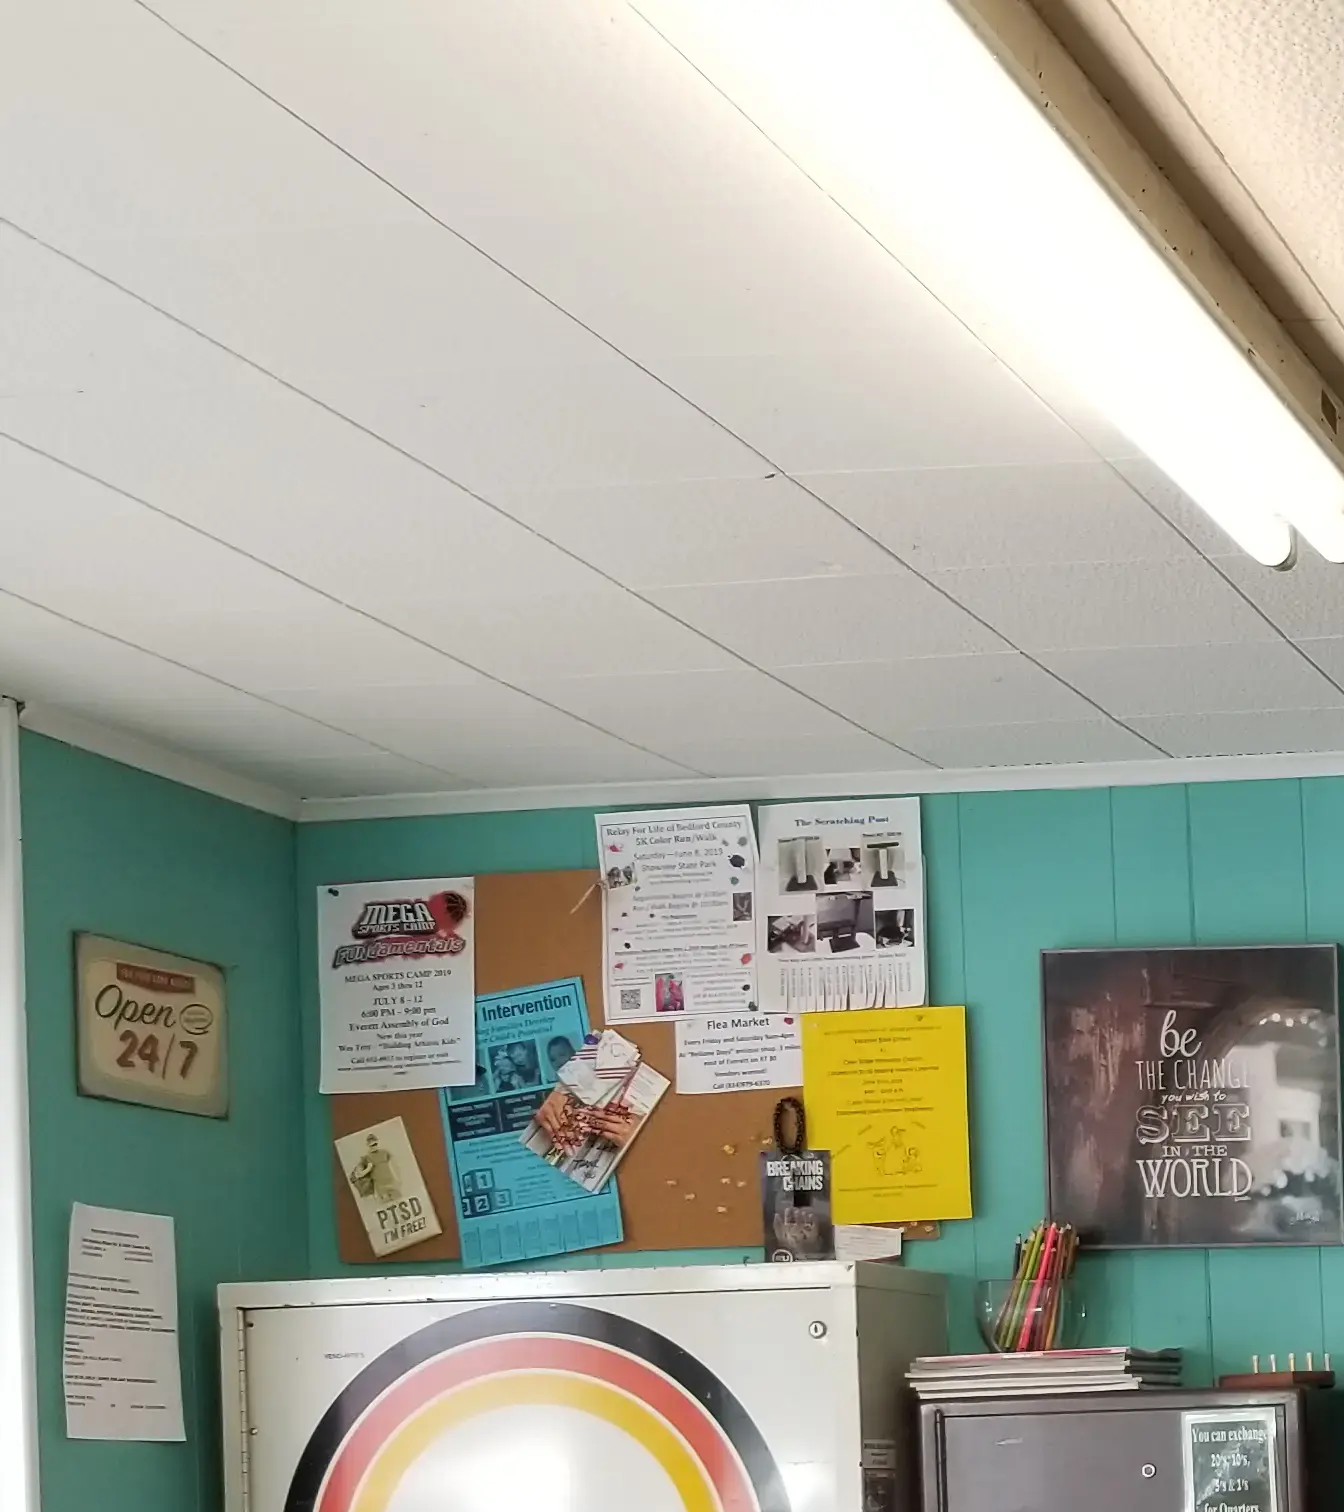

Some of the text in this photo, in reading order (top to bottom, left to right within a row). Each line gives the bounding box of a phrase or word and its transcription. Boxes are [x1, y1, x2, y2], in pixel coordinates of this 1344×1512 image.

[633, 826, 645, 834] For
[648, 825, 663, 833] Life
[676, 823, 710, 832] Bedford
[712, 821, 742, 829] County
[795, 819, 812, 827] The
[815, 817, 865, 826] Scratching
[360, 903, 434, 925] MEGA
[357, 923, 400, 934] SPORTS
[345, 975, 370, 983] MEGA
[372, 973, 404, 981] SPORTS
[406, 971, 432, 979] CAMP
[95, 984, 176, 1031] Open
[373, 997, 398, 1006] JULY
[414, 995, 423, 1003] 12
[482, 994, 572, 1021] Intervention
[707, 1018, 770, 1030] Flea Market
[1160, 1009, 1202, 1058] be
[116, 1029, 198, 1080] 24/7
[1135, 1058, 1251, 1090] THE CHANGE
[1161, 1090, 1227, 1104] you wish to
[1135, 1103, 1252, 1144] SEE
[1162, 1145, 1228, 1157] IN THE
[767, 1160, 824, 1176] BREAKING
[783, 1176, 823, 1191] CHAINS
[1136, 1158, 1253, 1199] WORLD
[377, 1196, 422, 1229] PTSD
[383, 1217, 427, 1244] I'M FREE!
[1192, 1428, 1209, 1443] You
[1211, 1430, 1226, 1442] can
[1237, 1479, 1248, 1491] 1's
